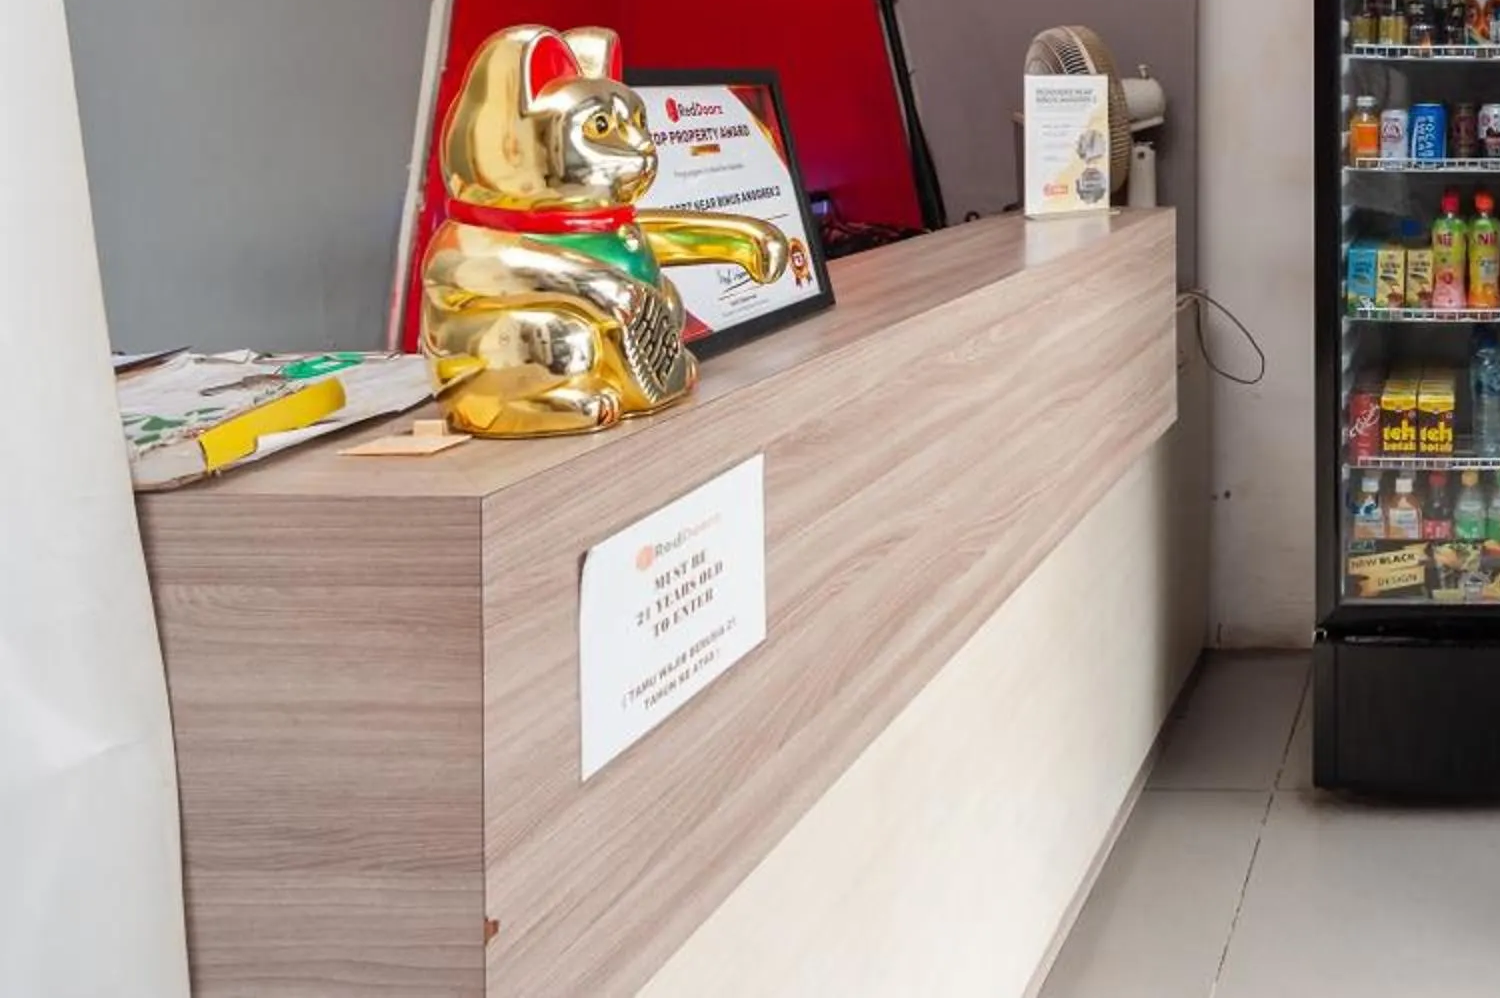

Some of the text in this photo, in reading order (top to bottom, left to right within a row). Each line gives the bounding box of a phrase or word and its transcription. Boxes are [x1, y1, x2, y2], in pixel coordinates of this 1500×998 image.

[650, 123, 750, 145] OP PROPERTY AWARD
[655, 549, 707, 590] MUST BE
[636, 560, 724, 626] 21 YEARS OLD
[654, 587, 714, 638] TO ENTER
